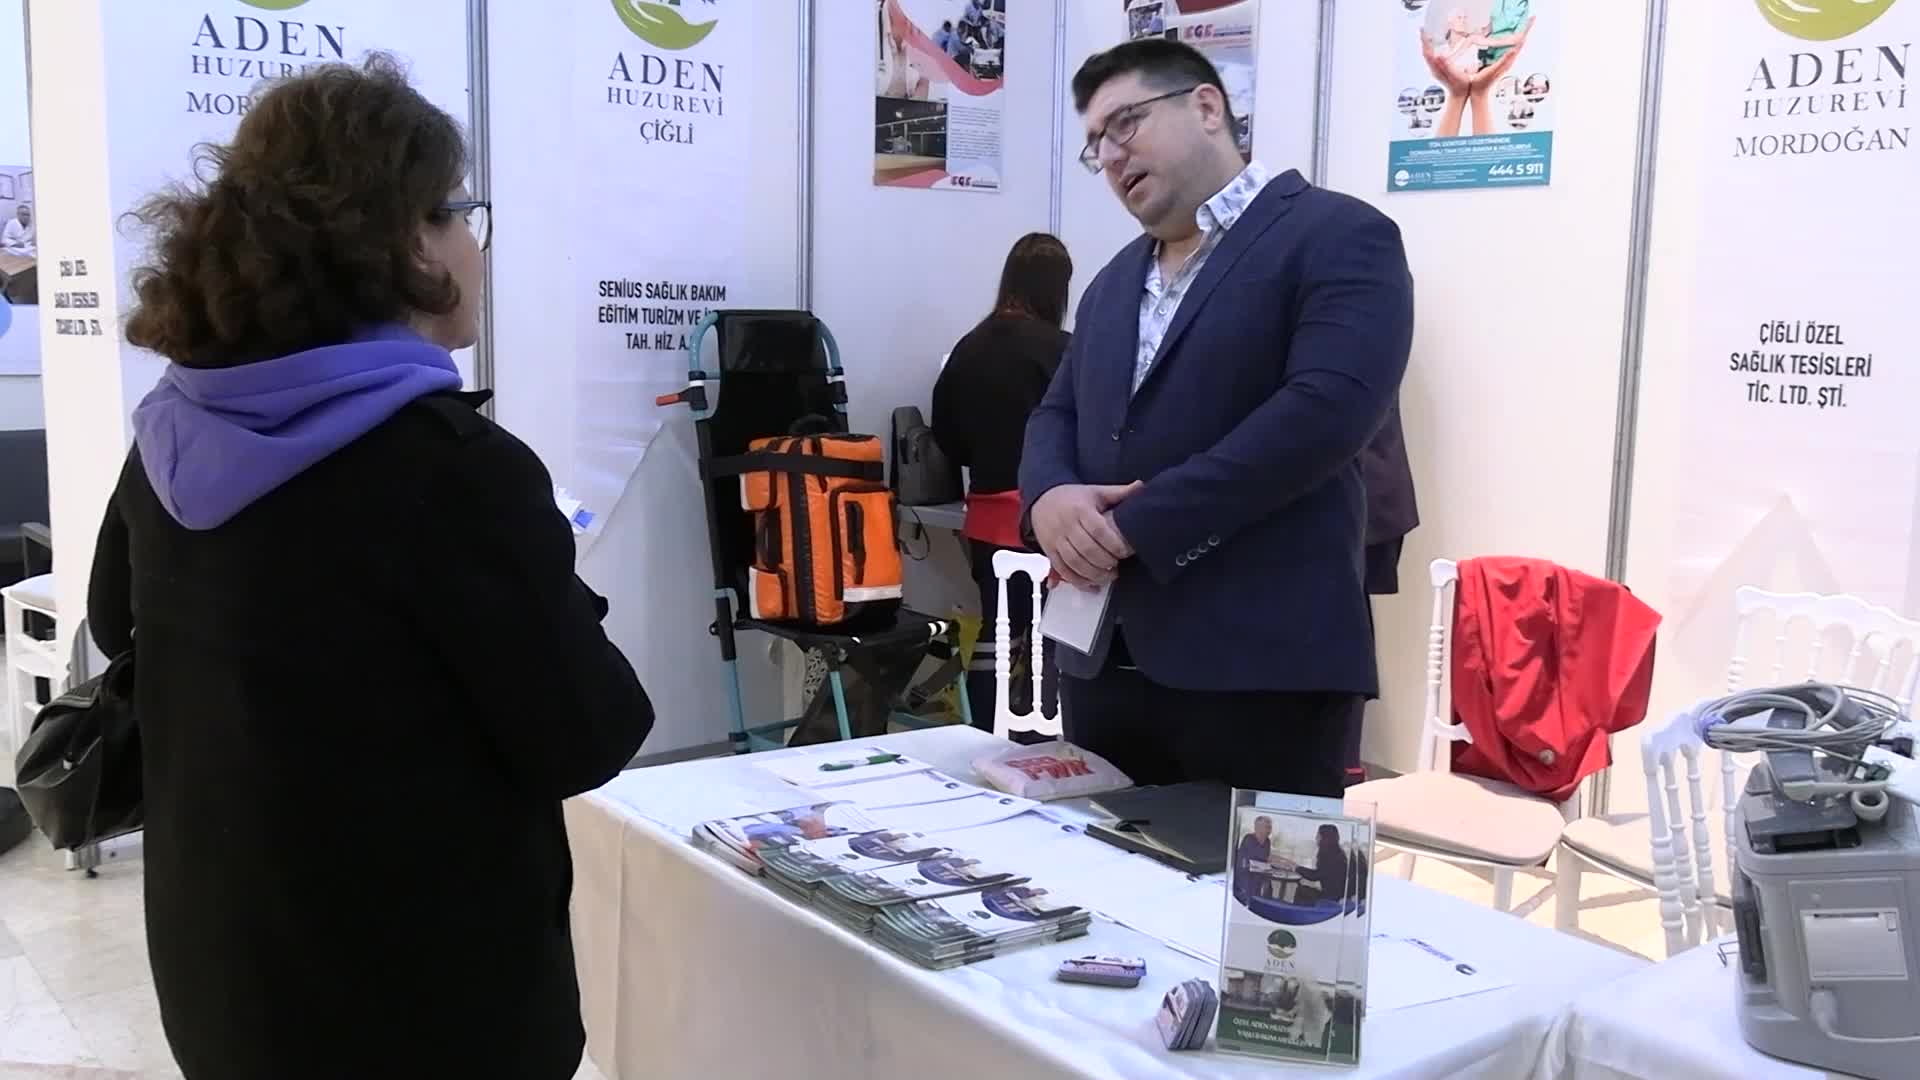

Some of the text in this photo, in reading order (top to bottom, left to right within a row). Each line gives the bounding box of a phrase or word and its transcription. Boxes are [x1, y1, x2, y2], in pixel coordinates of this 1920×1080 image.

[192, 13, 345, 59] ADEN
[607, 51, 724, 93] ADEN
[1746, 43, 1911, 91] ADEN
[607, 86, 724, 116] HUZUREVİ
[1743, 84, 1906, 119] HUZUREVİ
[639, 118, 694, 145] ÇİĞLİ
[1734, 125, 1911, 158] MORDOĞAN
[1488, 162, 1544, 176] 444 5 911
[598, 278, 727, 302] SENİUS SAĞLIK BAKIM
[598, 303, 639, 324] EĞİTİM
[641, 305, 685, 326] TURİZM
[625, 332, 651, 350] TAH.
[655, 331, 676, 351] HİZ.
[1759, 320, 1844, 345] ÇİĞLİ ÖZEL
[1729, 350, 1872, 377] SAĞLIK TESİSLERİ
[1747, 379, 1847, 408] TİC. LTD. ŞTİ.
